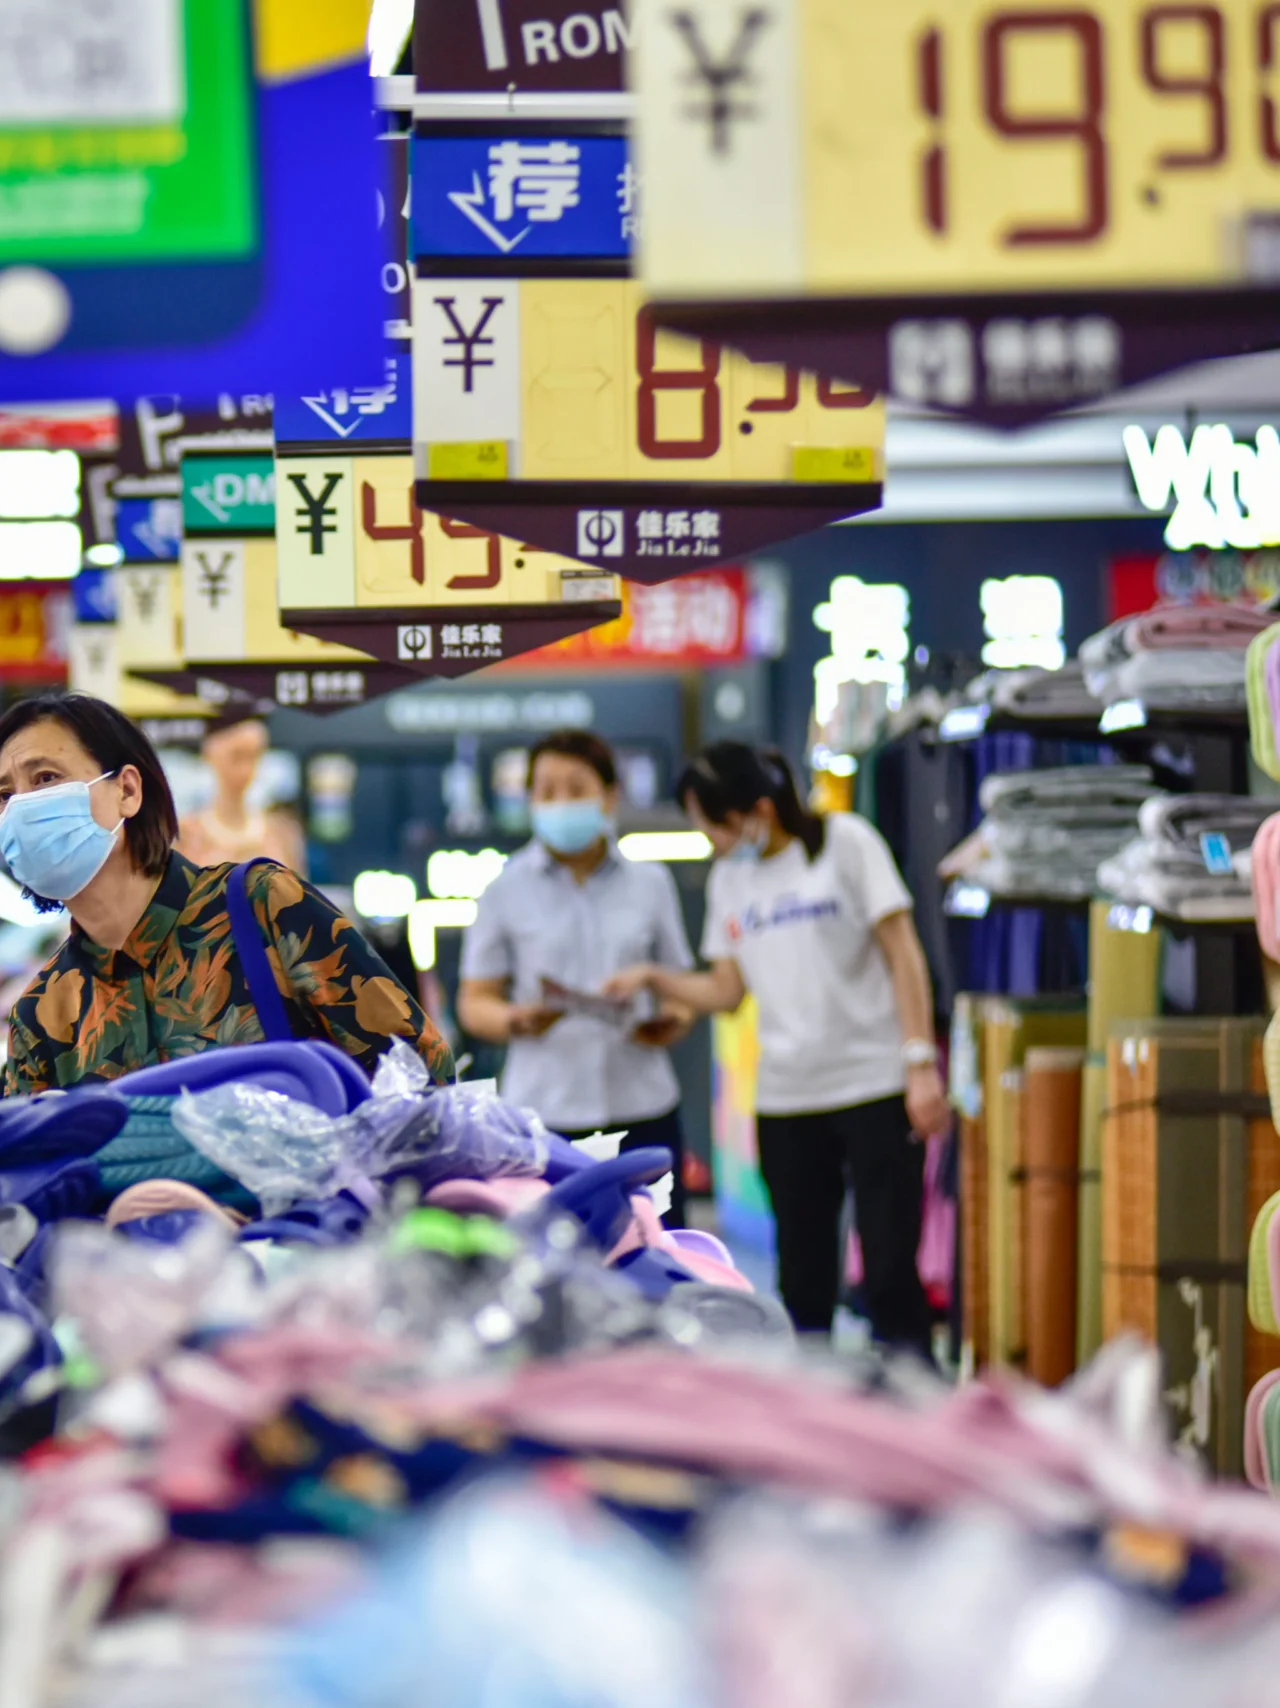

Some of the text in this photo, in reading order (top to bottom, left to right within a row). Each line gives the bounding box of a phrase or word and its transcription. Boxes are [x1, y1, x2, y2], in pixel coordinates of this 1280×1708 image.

[668, 5, 1280, 250] ¥ 19.9
[433, 297, 504, 393] ¥
[286, 472, 344, 555] ¥
[636, 510, 720, 538] 佳乐家
